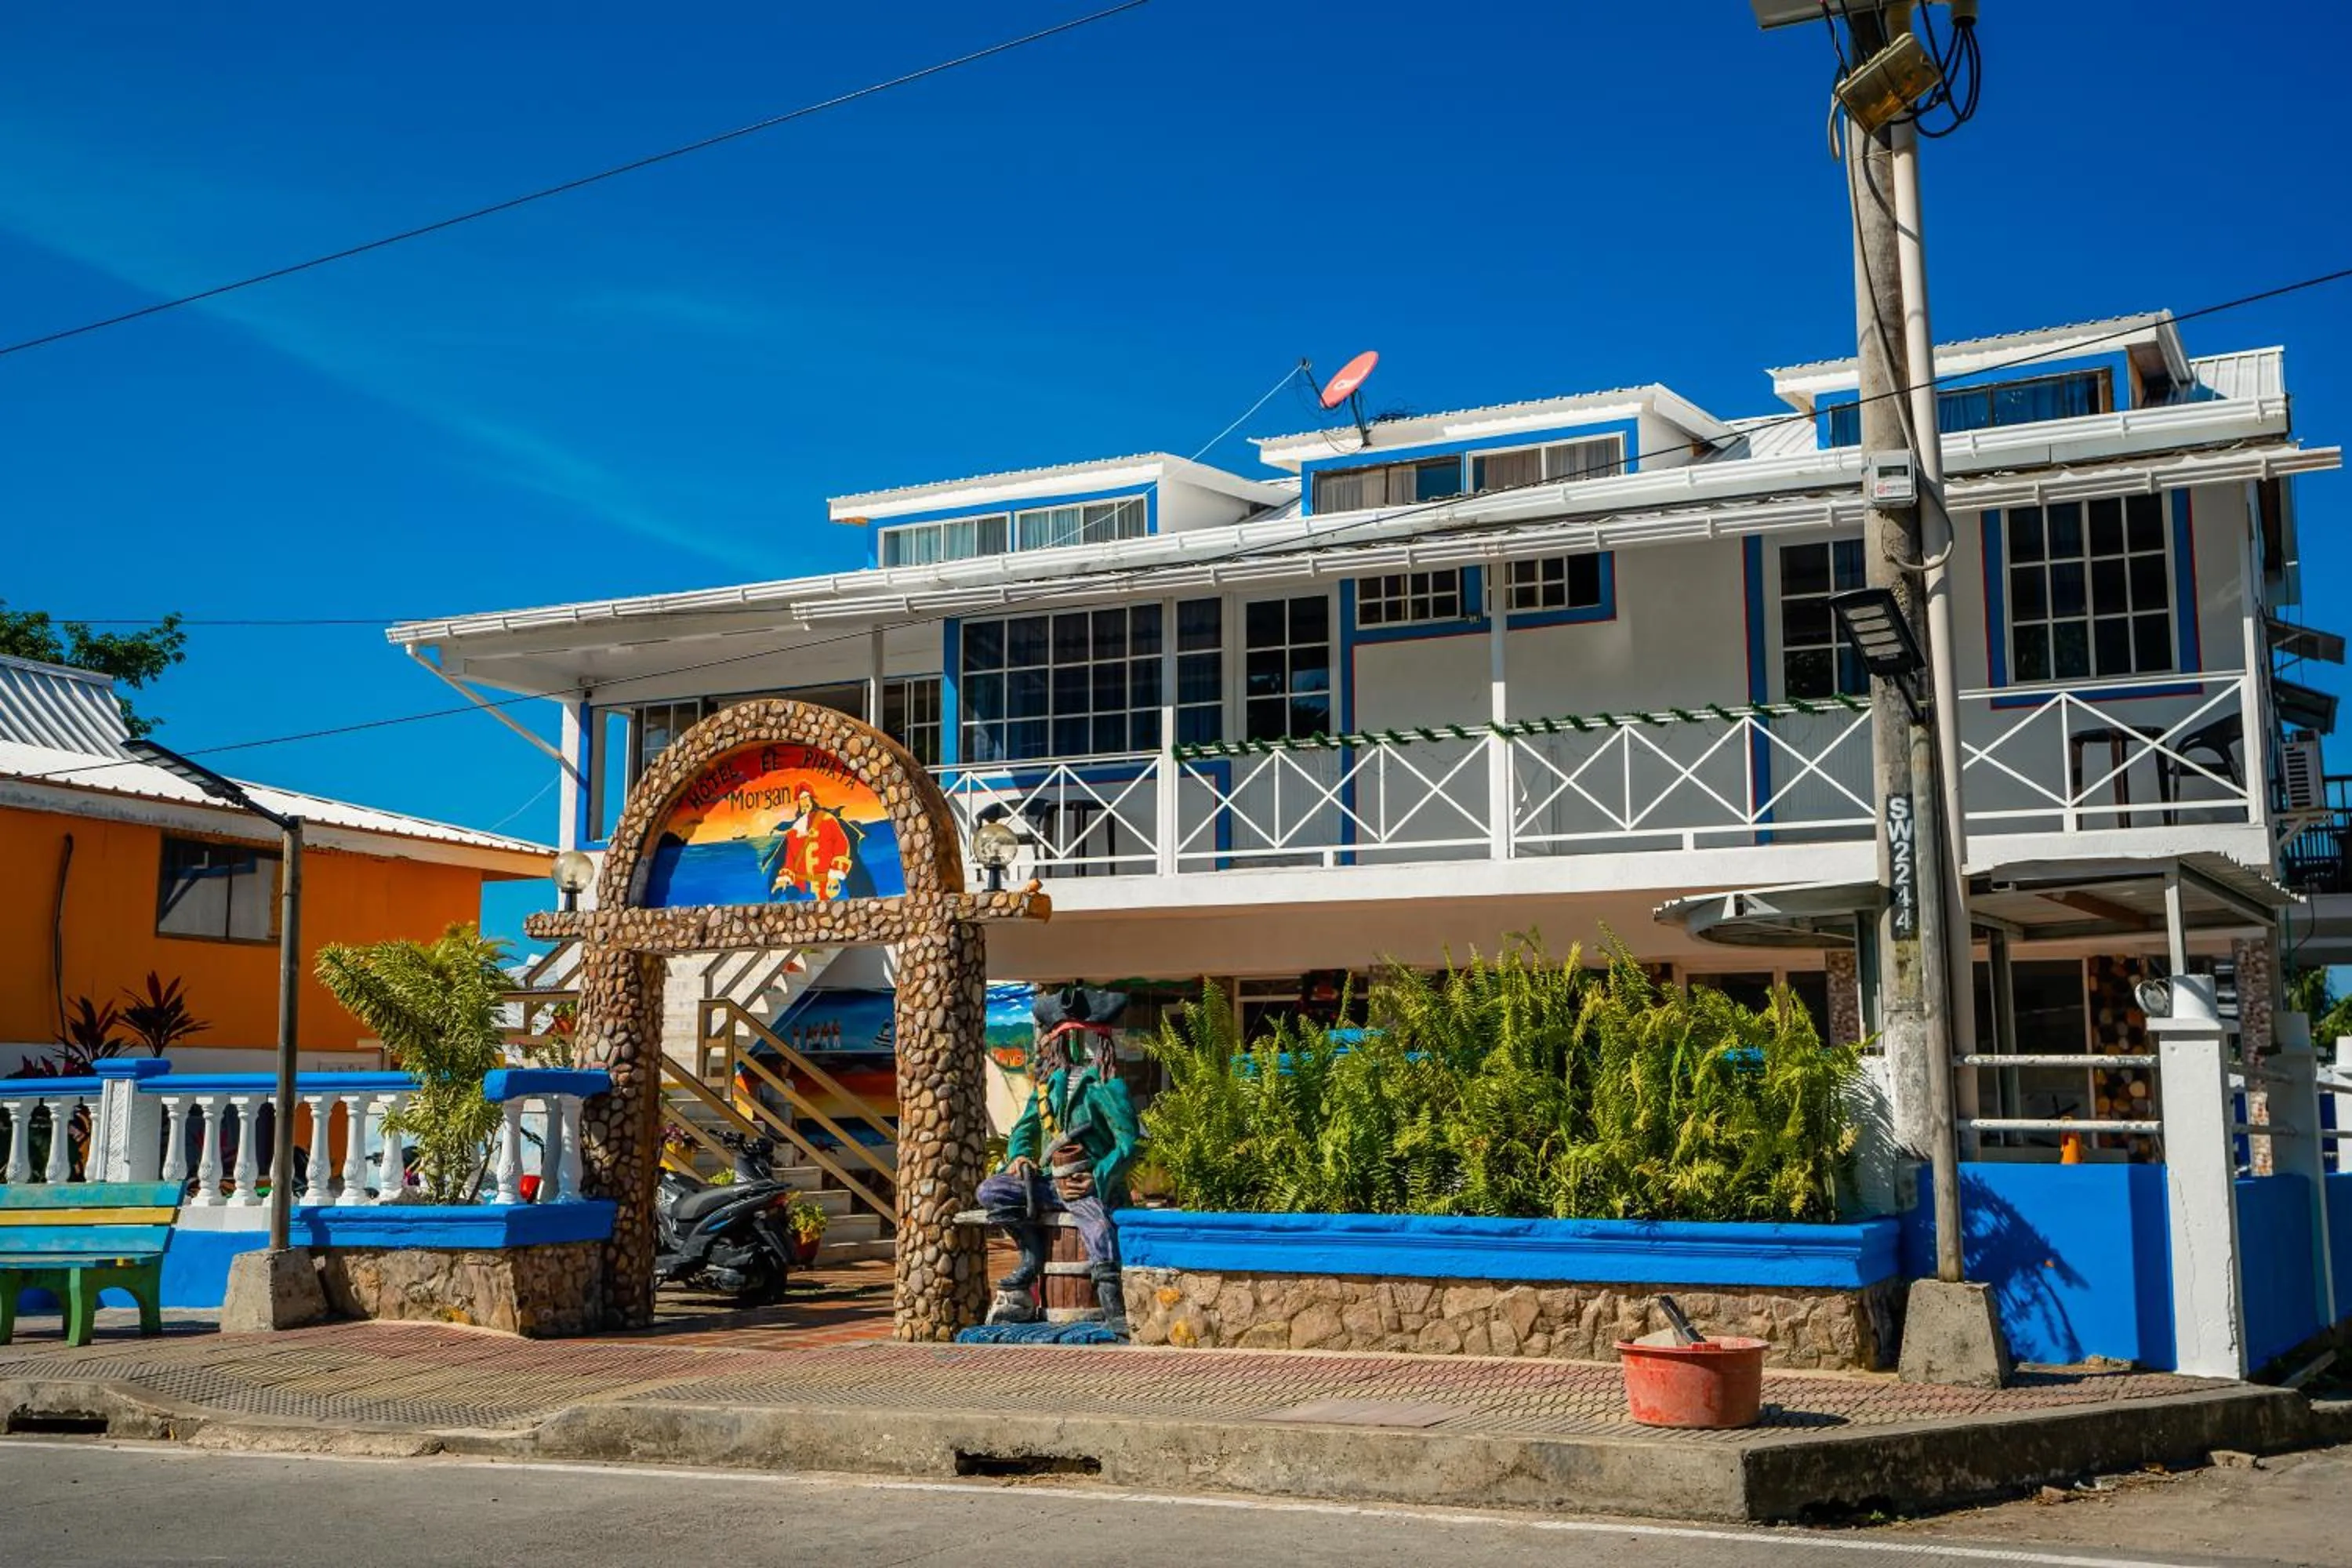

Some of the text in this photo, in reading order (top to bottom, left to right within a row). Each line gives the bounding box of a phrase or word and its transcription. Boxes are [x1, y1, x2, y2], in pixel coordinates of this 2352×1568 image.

[688, 764, 739, 811] HOTEL
[803, 750, 859, 790] PIRATA
[728, 786, 791, 811] Morgan
[1886, 797, 1913, 931] SW2244
